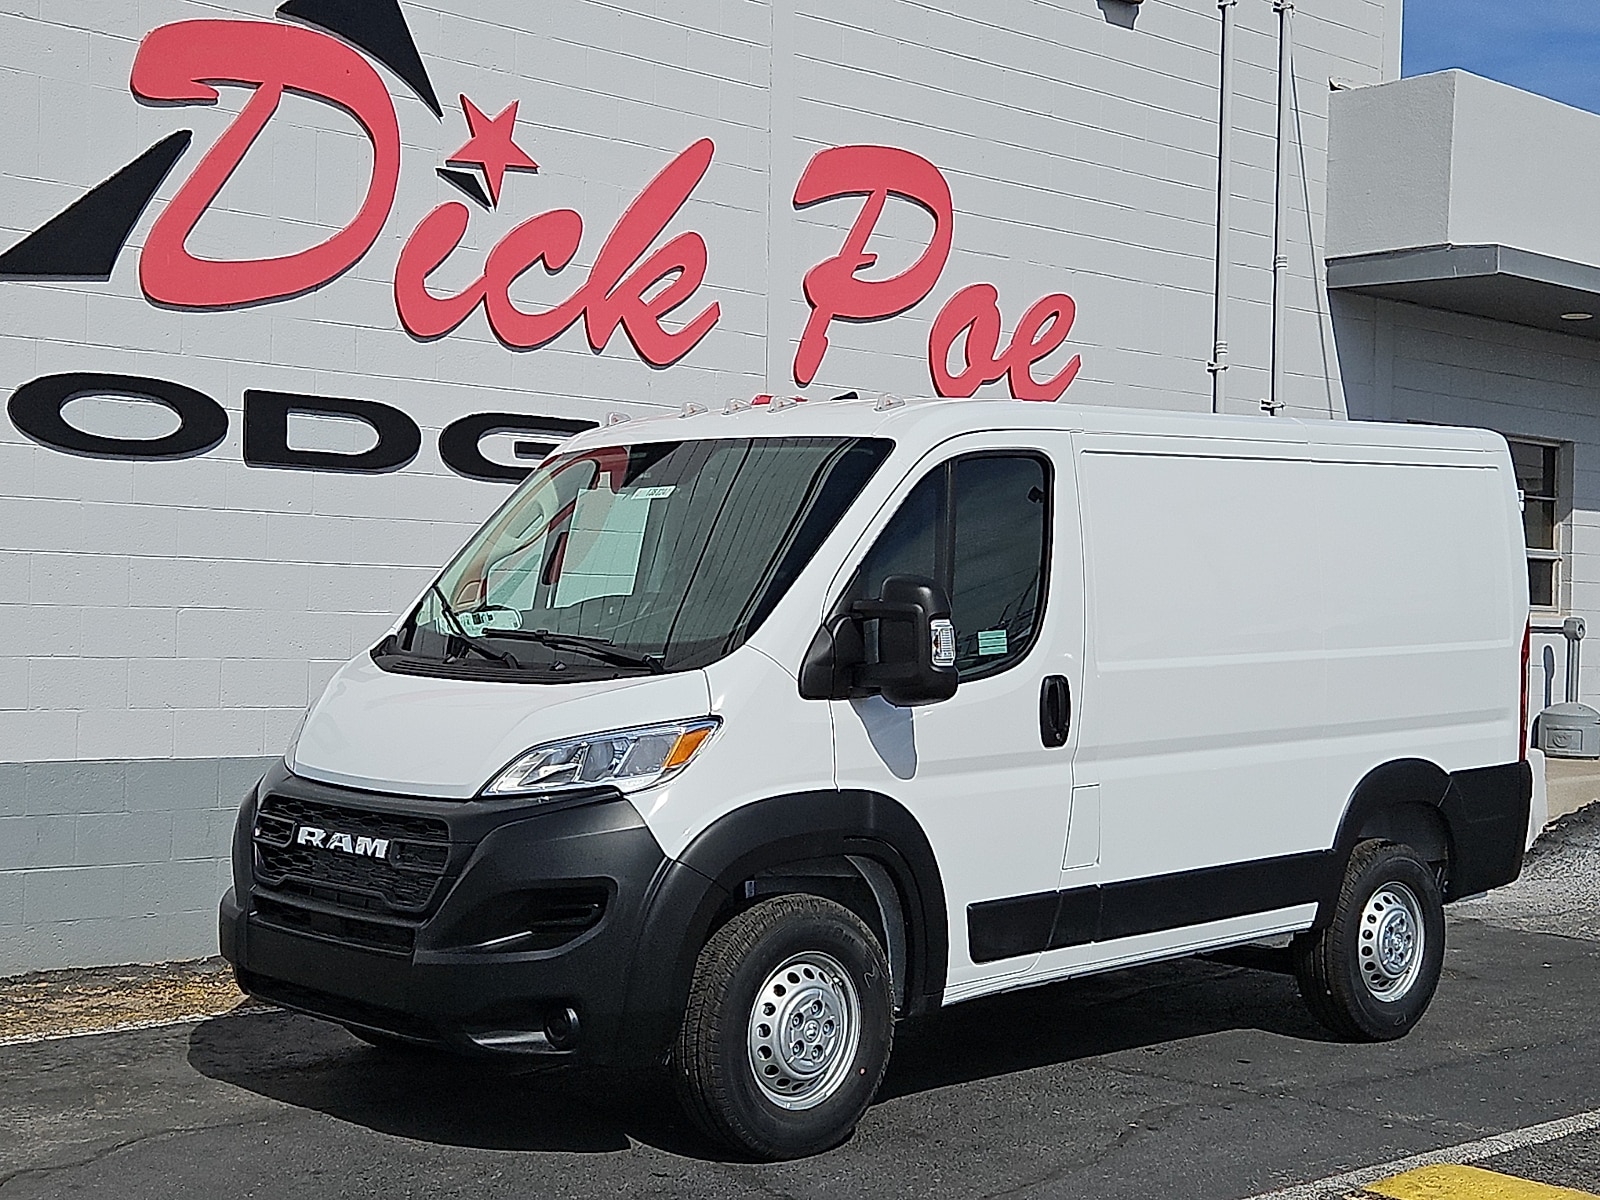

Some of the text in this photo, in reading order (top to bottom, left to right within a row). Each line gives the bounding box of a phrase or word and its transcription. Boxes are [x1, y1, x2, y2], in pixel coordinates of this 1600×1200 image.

[131, 19, 1081, 400] Dick Poe
[297, 826, 389, 859] RAM
